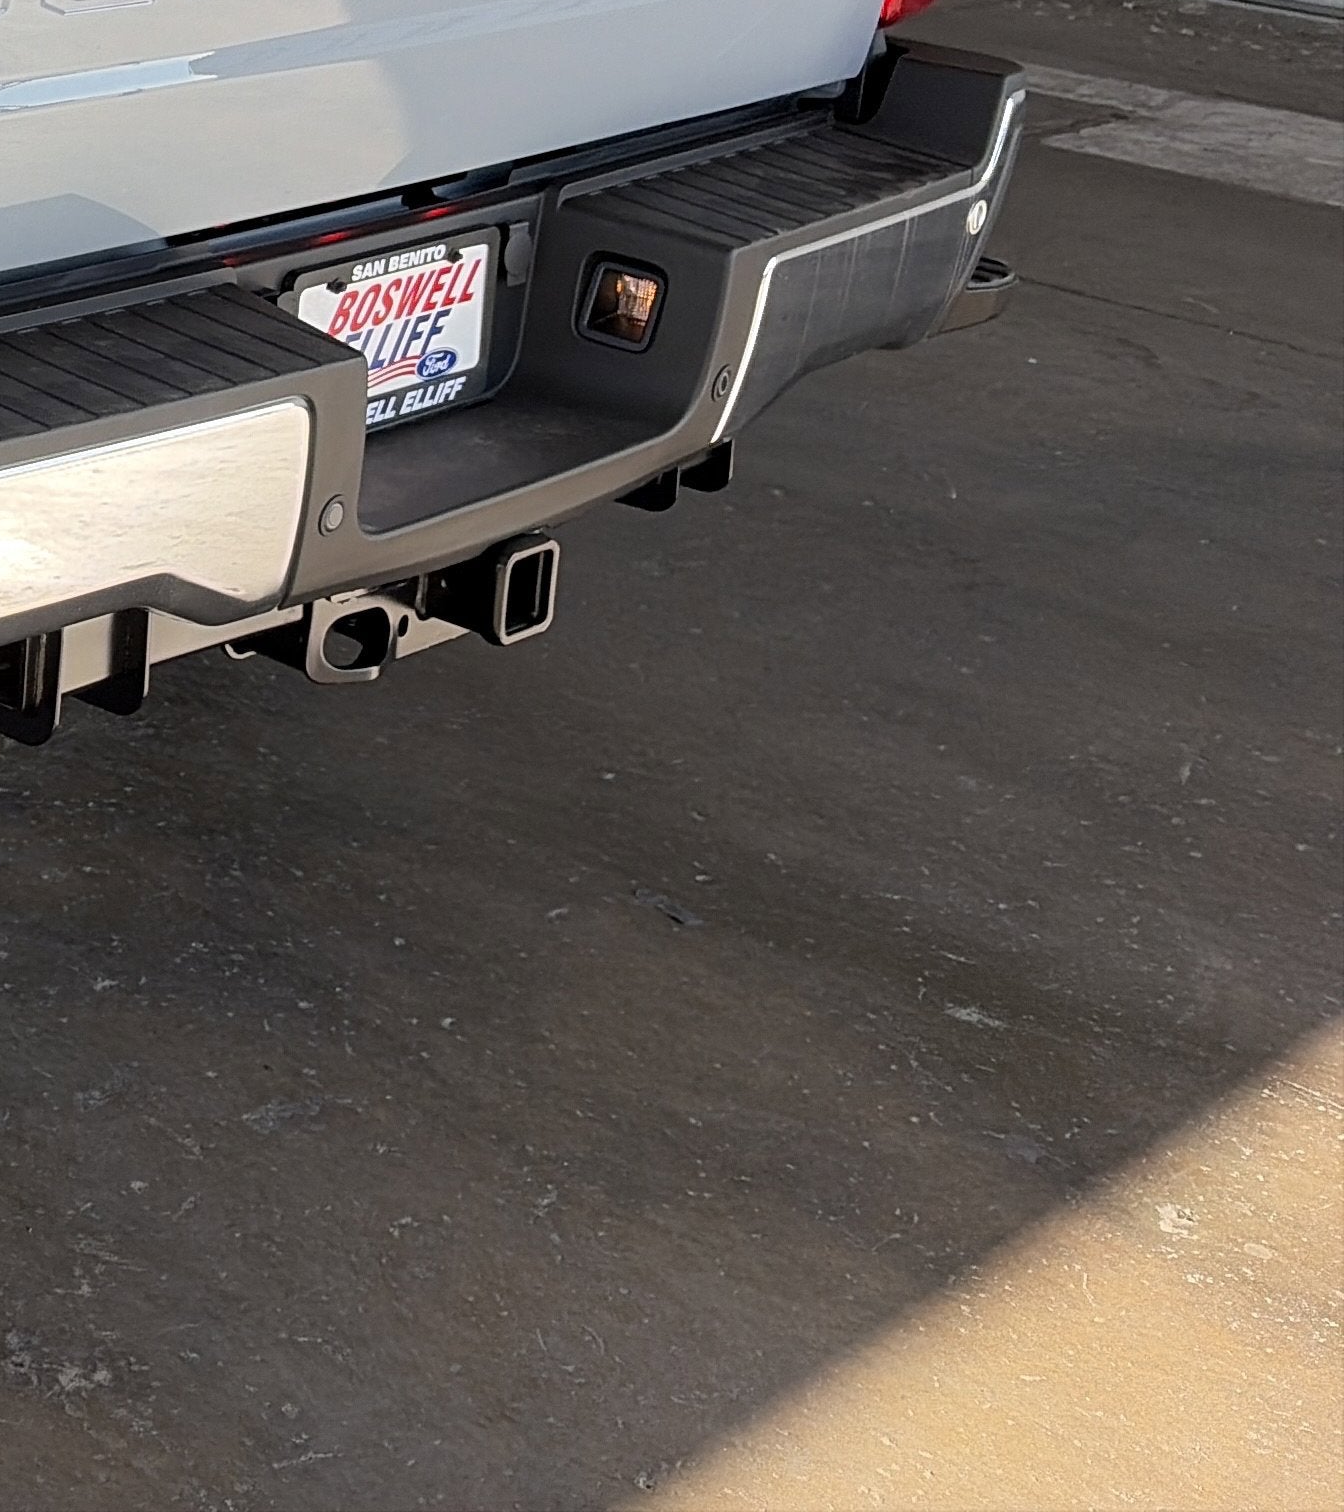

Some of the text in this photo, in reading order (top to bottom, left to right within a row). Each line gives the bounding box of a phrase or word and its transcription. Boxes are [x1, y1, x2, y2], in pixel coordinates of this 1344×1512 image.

[351, 244, 447, 282] SAN BENITO
[327, 258, 482, 336] BOSWELL
[345, 308, 453, 371] LIFF
[422, 353, 451, 376] Ford
[398, 375, 467, 416] ELLIFF
